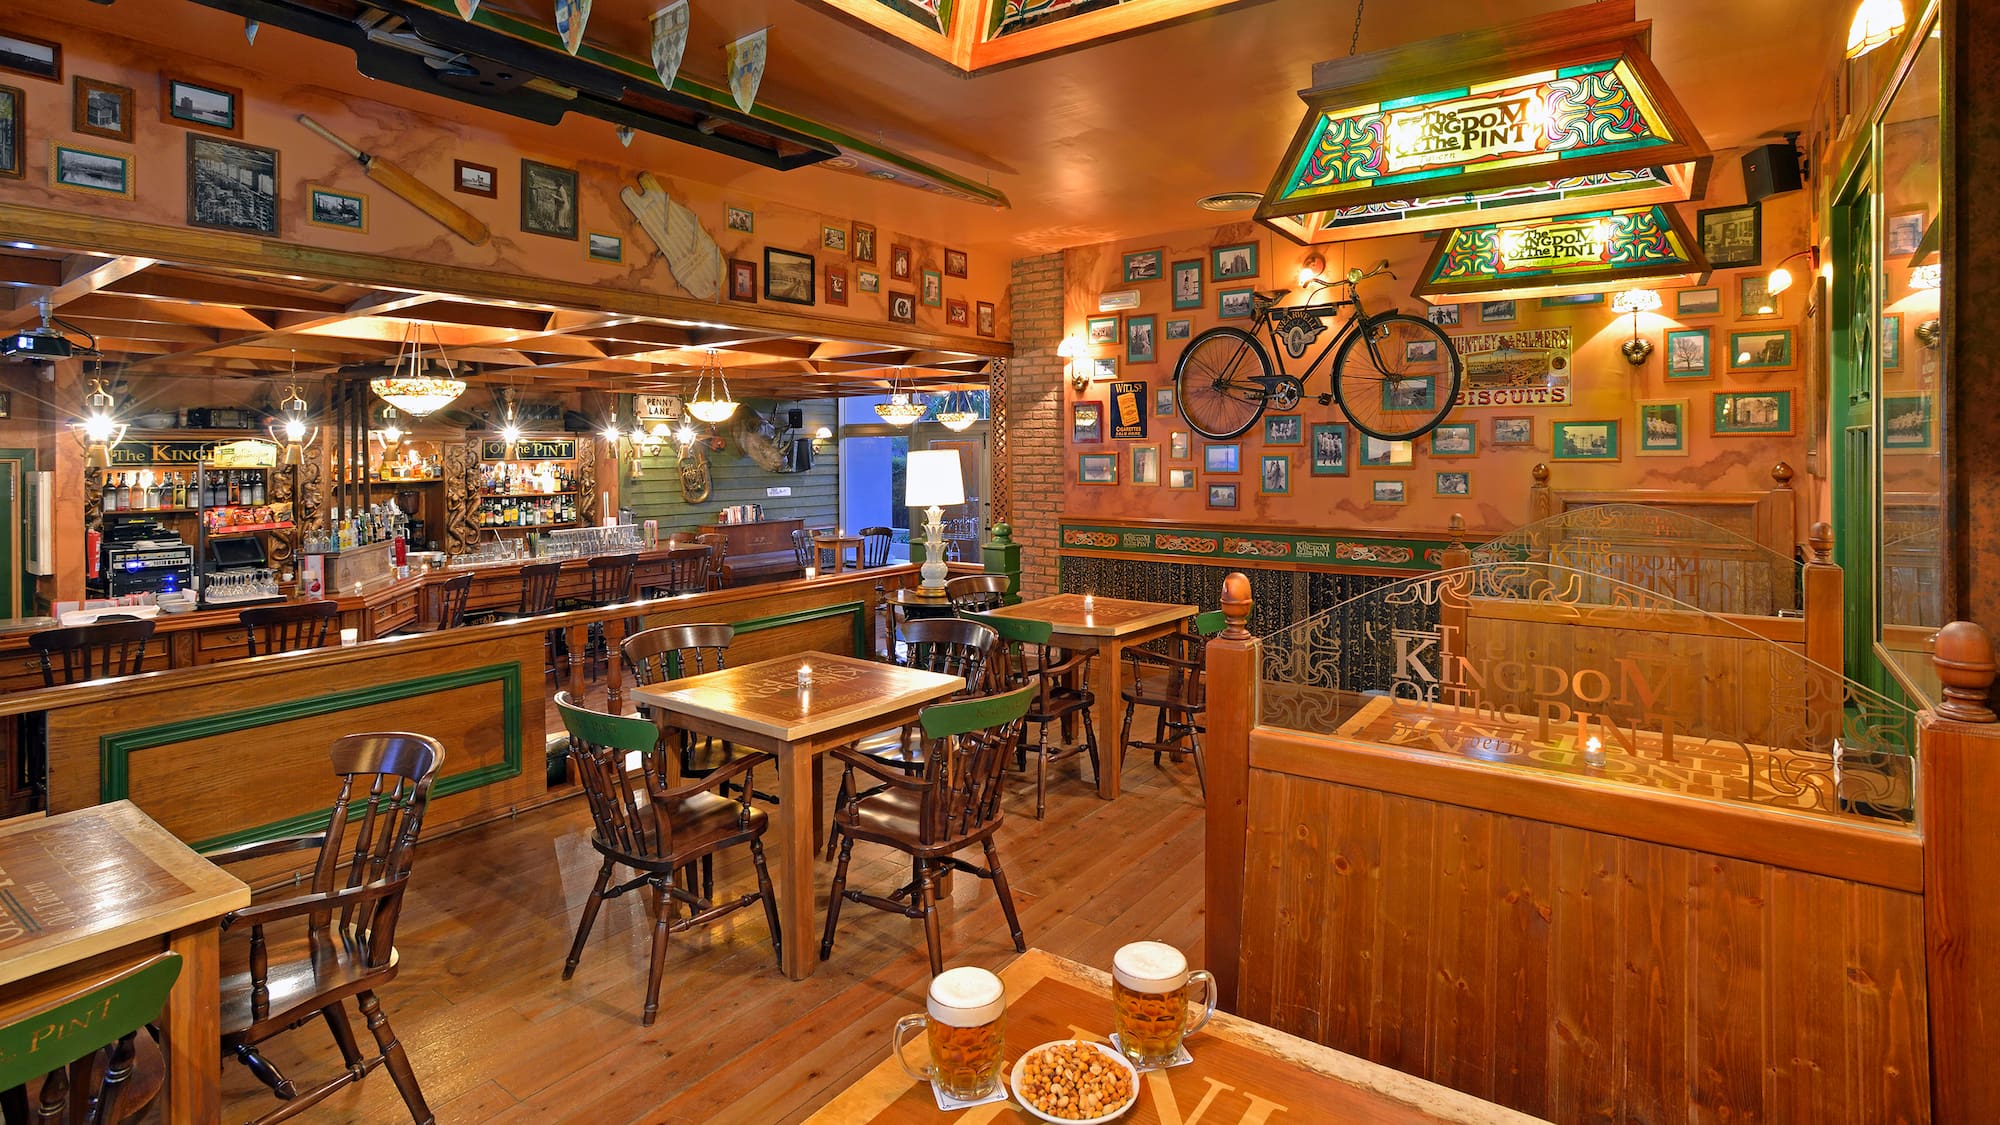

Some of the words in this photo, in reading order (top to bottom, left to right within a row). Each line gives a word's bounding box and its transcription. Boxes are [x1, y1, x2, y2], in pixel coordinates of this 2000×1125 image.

[1410, 98, 1531, 136] INGDOM
[1423, 110, 1457, 123] The
[1423, 133, 1460, 150] The
[1462, 122, 1531, 151] PINT
[1516, 229, 1594, 248] INGDOM
[1523, 229, 1549, 240] The
[1526, 246, 1551, 257] The
[1552, 241, 1598, 258] PINT
[1516, 329, 1569, 350] PALMERS
[646, 398, 673, 408] PENNY
[648, 406, 670, 416] LANE
[115, 449, 147, 462] The
[532, 442, 570, 458] PINT
[1550, 543, 1699, 573] KINGDOM
[1391, 636, 1683, 712] KINGDOM
[1391, 680, 1439, 713] Of
[1443, 686, 1521, 725] The
[1535, 699, 1688, 764] PINT
[29, 993, 120, 1054] PINT
